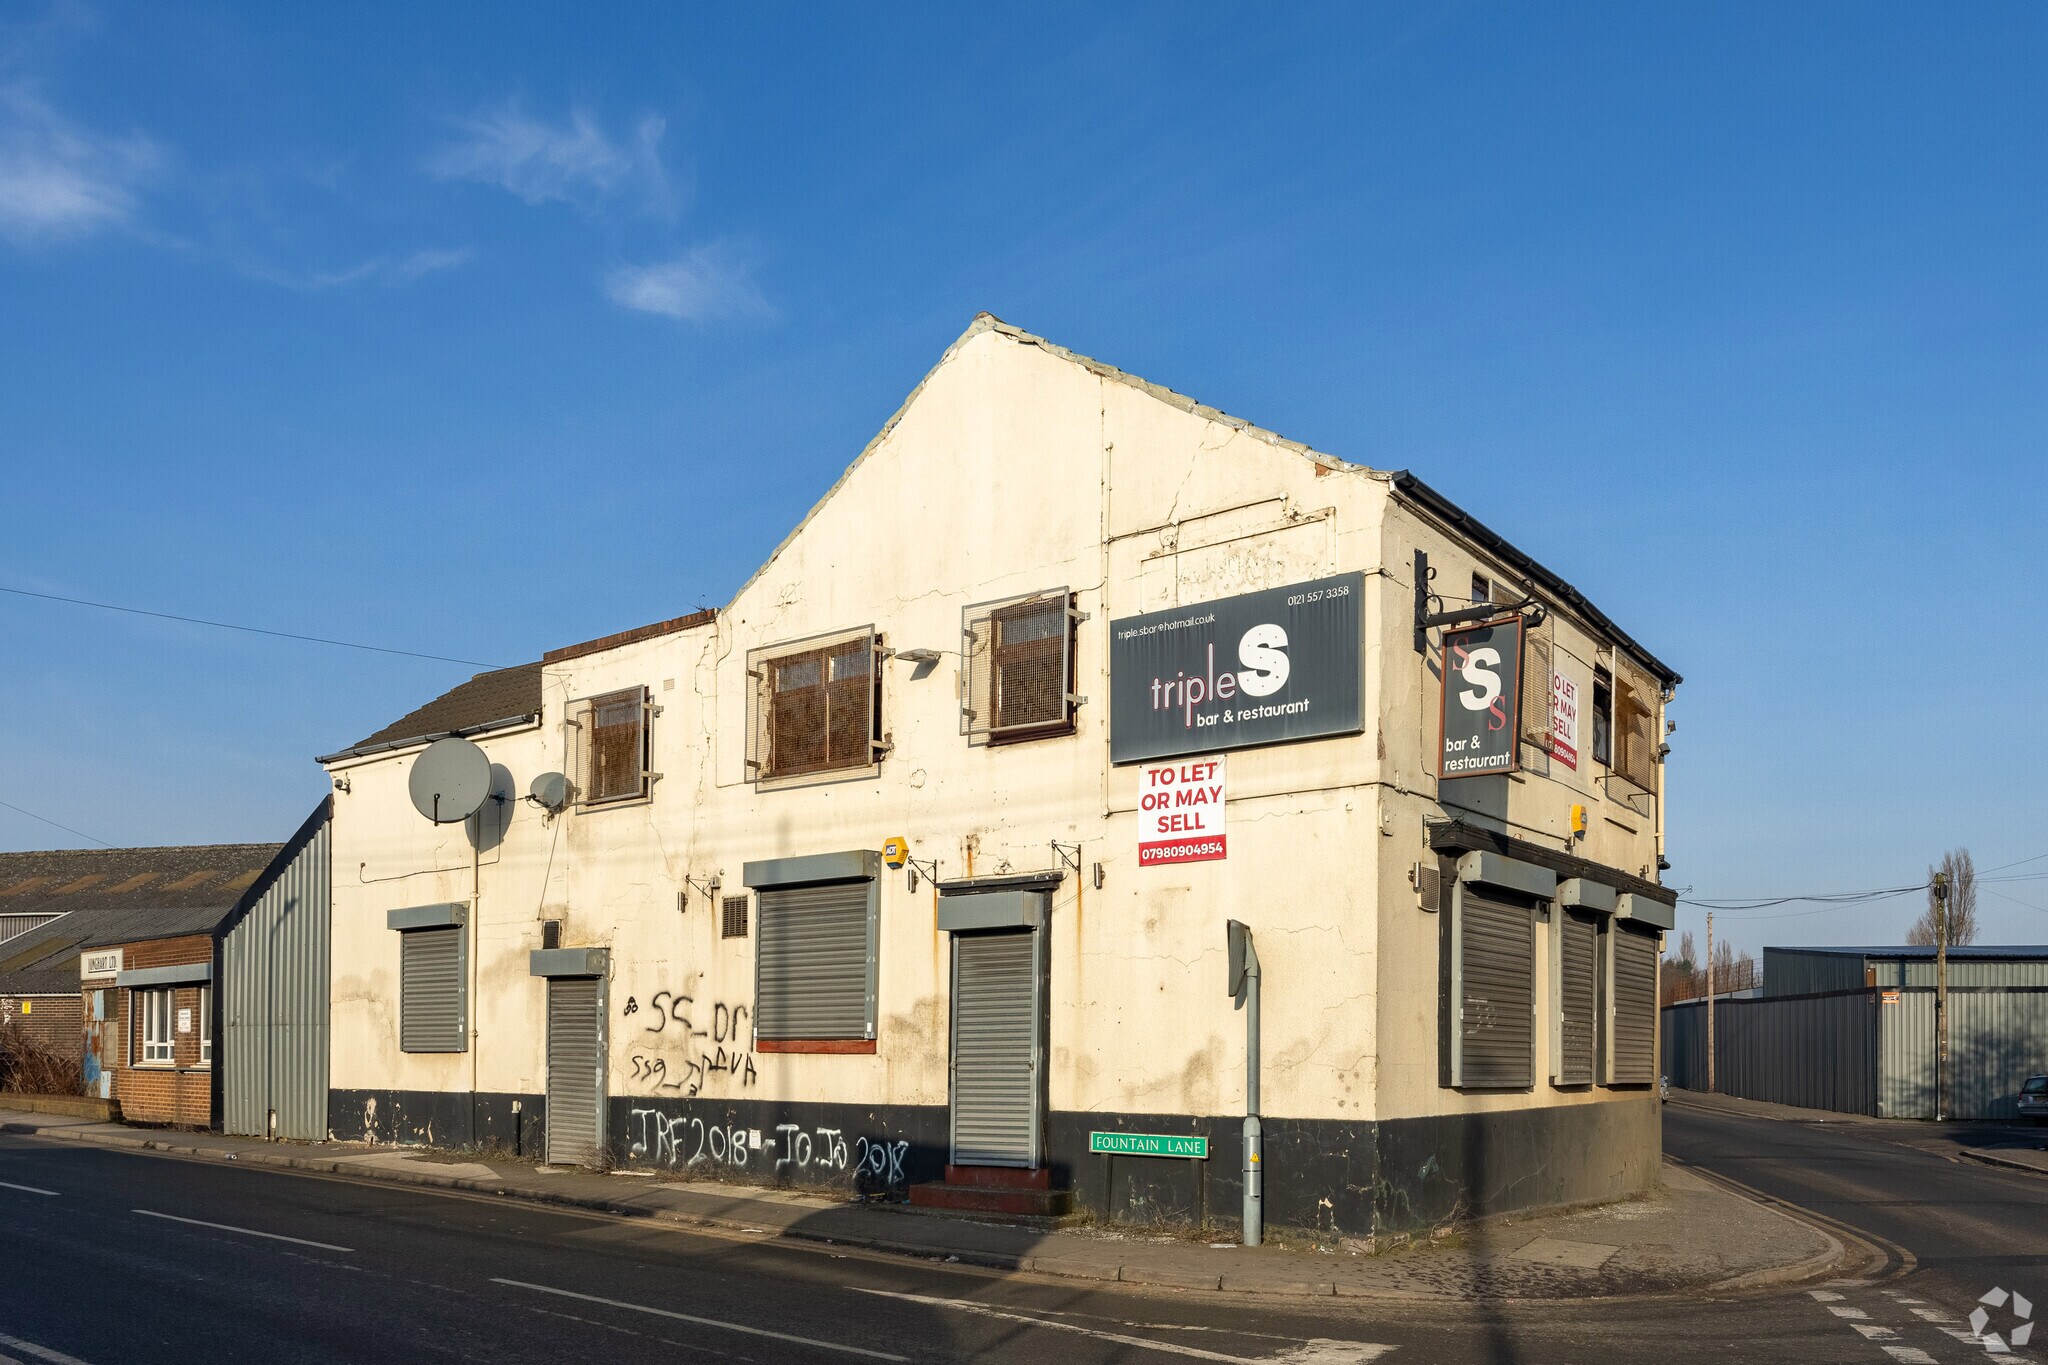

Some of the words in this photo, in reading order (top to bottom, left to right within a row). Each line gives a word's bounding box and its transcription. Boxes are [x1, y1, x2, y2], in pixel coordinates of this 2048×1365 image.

[1288, 594, 1305, 606] 0121
[1307, 591, 1323, 602] 557
[1326, 586, 1349, 598] 3358
[1118, 613, 1216, 640] triple.sbar@hotmail.co.uk
[1459, 647, 1502, 711] S
[1562, 680, 1574, 700] LET
[1197, 712, 1219, 727] bar
[1223, 709, 1234, 723] &
[1237, 698, 1310, 721] restaurant
[1561, 699, 1576, 722] MAY
[1554, 716, 1571, 739] SELL
[1446, 737, 1467, 752] bar
[1470, 735, 1480, 749] &
[1445, 751, 1511, 771] restaurant
[1148, 768, 1175, 787] TO
[1181, 762, 1218, 783] LET
[1141, 792, 1170, 811] OR
[1175, 785, 1222, 808] MAY
[1157, 812, 1205, 833] SELL
[1141, 842, 1223, 860] 07980904954
[1096, 1136, 1159, 1151] FOUNTAIN
[1168, 1140, 1201, 1154] LANE
